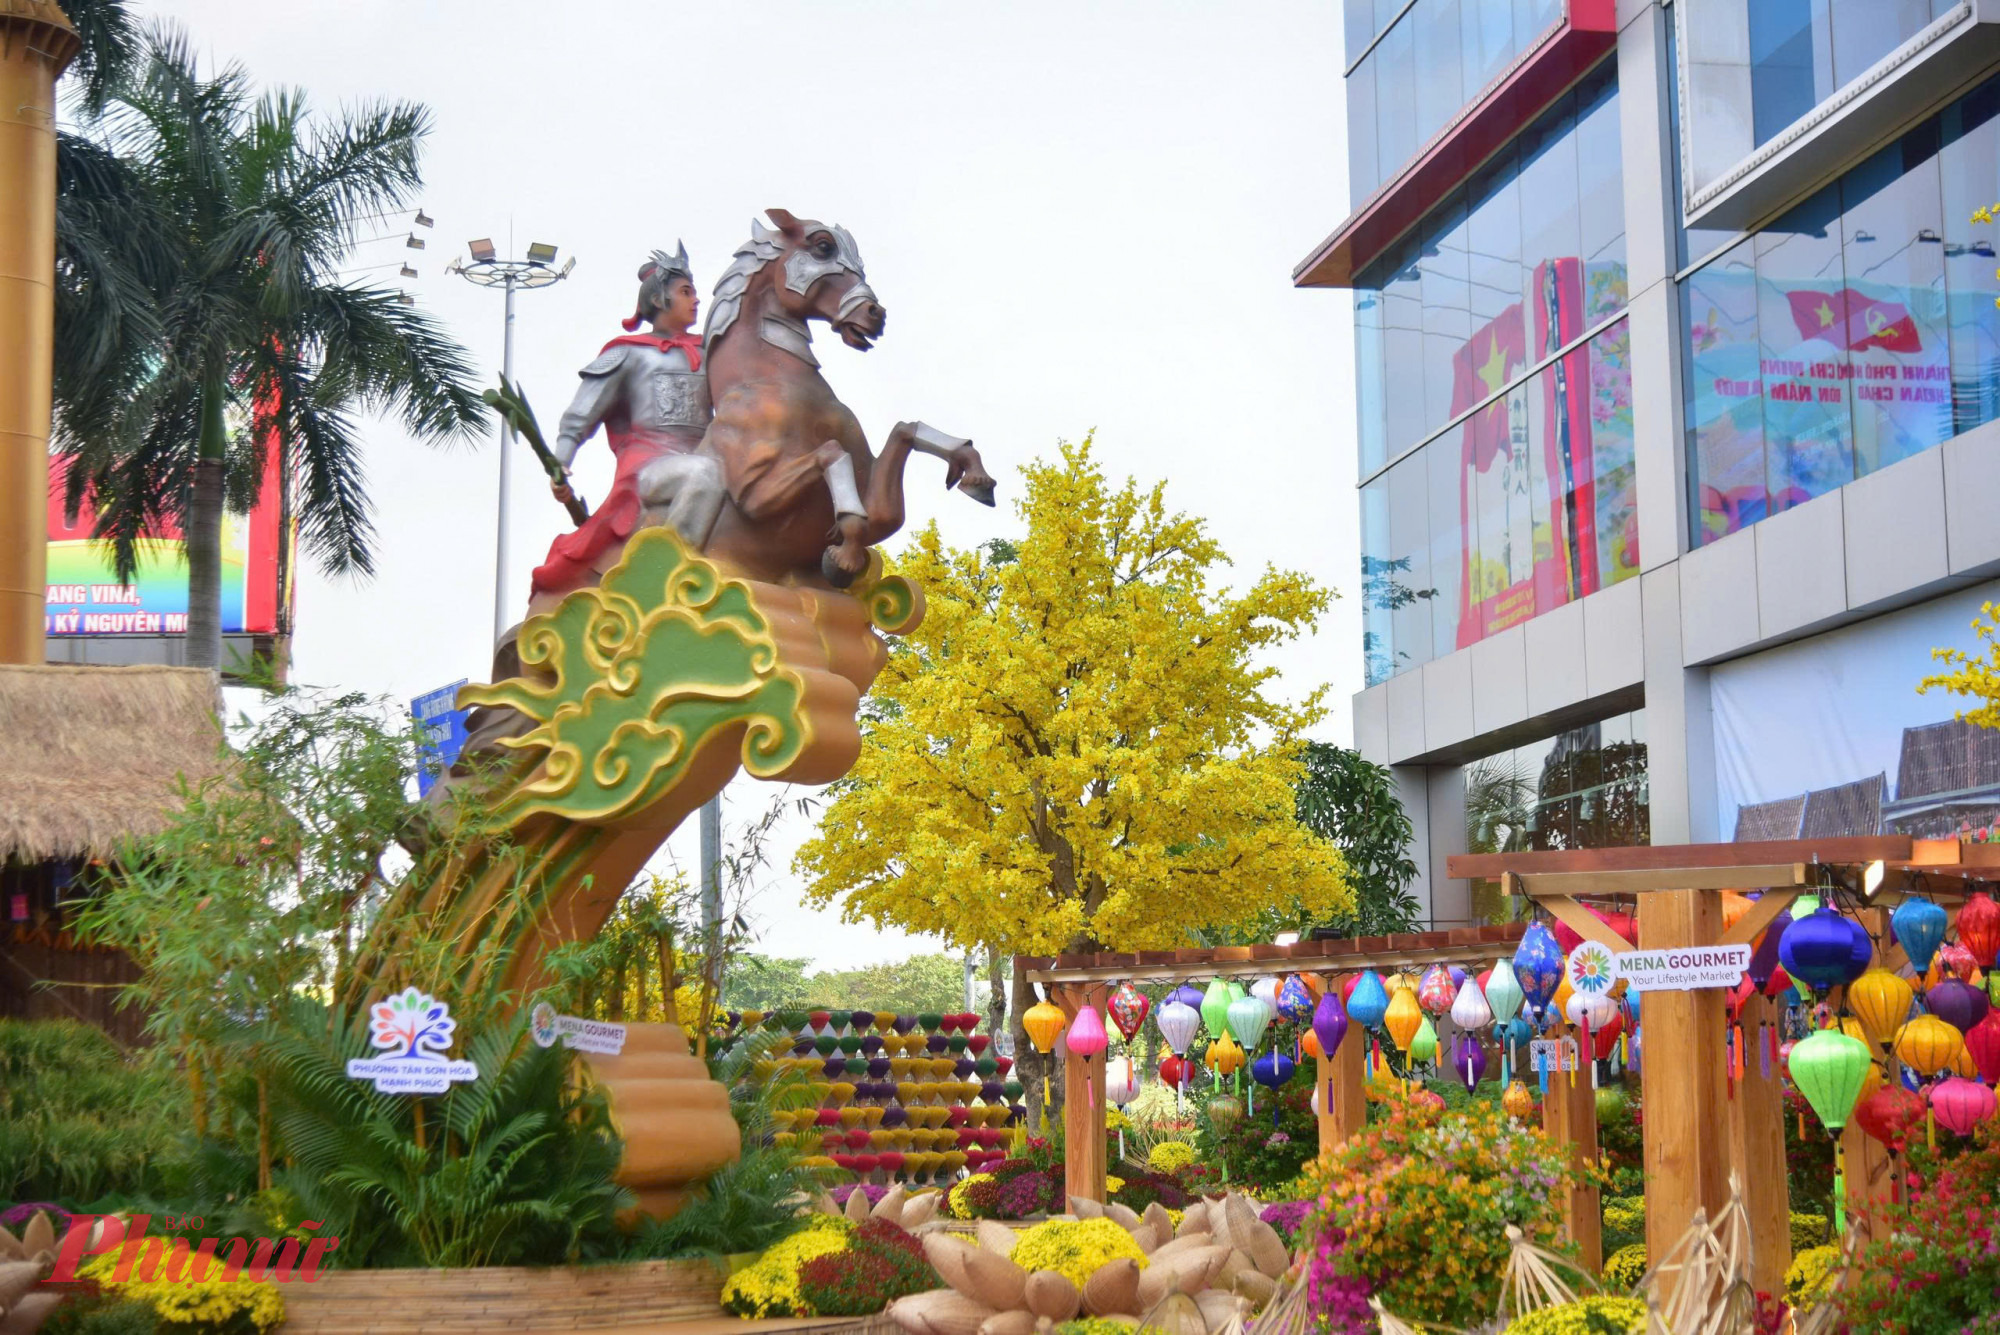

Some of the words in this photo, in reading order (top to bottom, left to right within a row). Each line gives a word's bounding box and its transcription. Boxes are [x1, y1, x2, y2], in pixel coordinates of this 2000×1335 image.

[47, 585, 86, 603] ANG
[91, 585, 141, 606] VINH,
[55, 607, 80, 632] KỶ
[85, 611, 160, 632] NGUYÊN
[1620, 955, 1666, 972] MENA
[1669, 951, 1745, 969] GOURMET
[1632, 975, 1655, 985] Your
[1657, 973, 1697, 985] Lifestyle
[1700, 971, 1735, 981] Market
[559, 1020, 583, 1034] MENA
[585, 1024, 624, 1039] GOURMET
[1532, 1043, 1555, 1051] SAIGO
